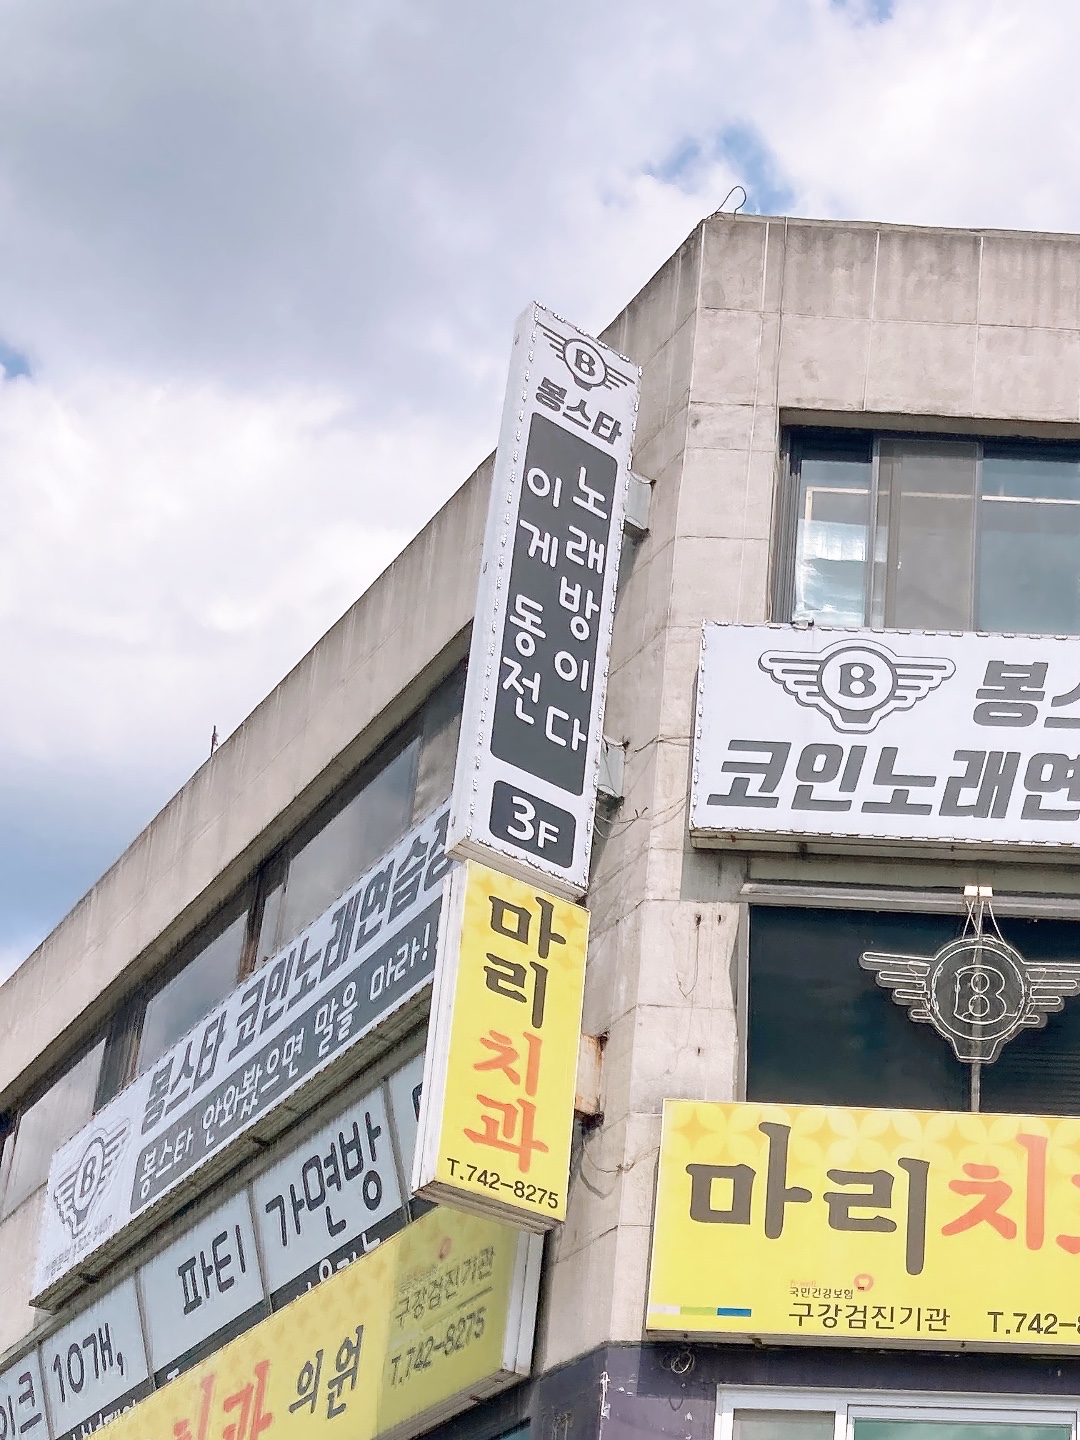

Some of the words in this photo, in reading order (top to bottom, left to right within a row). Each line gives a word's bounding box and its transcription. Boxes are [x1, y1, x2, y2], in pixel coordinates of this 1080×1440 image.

[535, 376, 622, 447] 봉스타
[505, 795, 560, 851] 3F
[141, 1010, 227, 1135] 봉스타
[464, 896, 566, 1173] 마리치과
[140, 1132, 192, 1199] 봉스타
[314, 980, 358, 1057] 말을
[177, 1224, 246, 1315] 파티
[266, 1112, 382, 1247] 가면방
[447, 1158, 558, 1210] T.742-8275
[396, 1246, 494, 1330] 구강검진기관
[789, 1302, 950, 1333] 구강검진기관
[391, 1307, 486, 1387] T.742-8275
